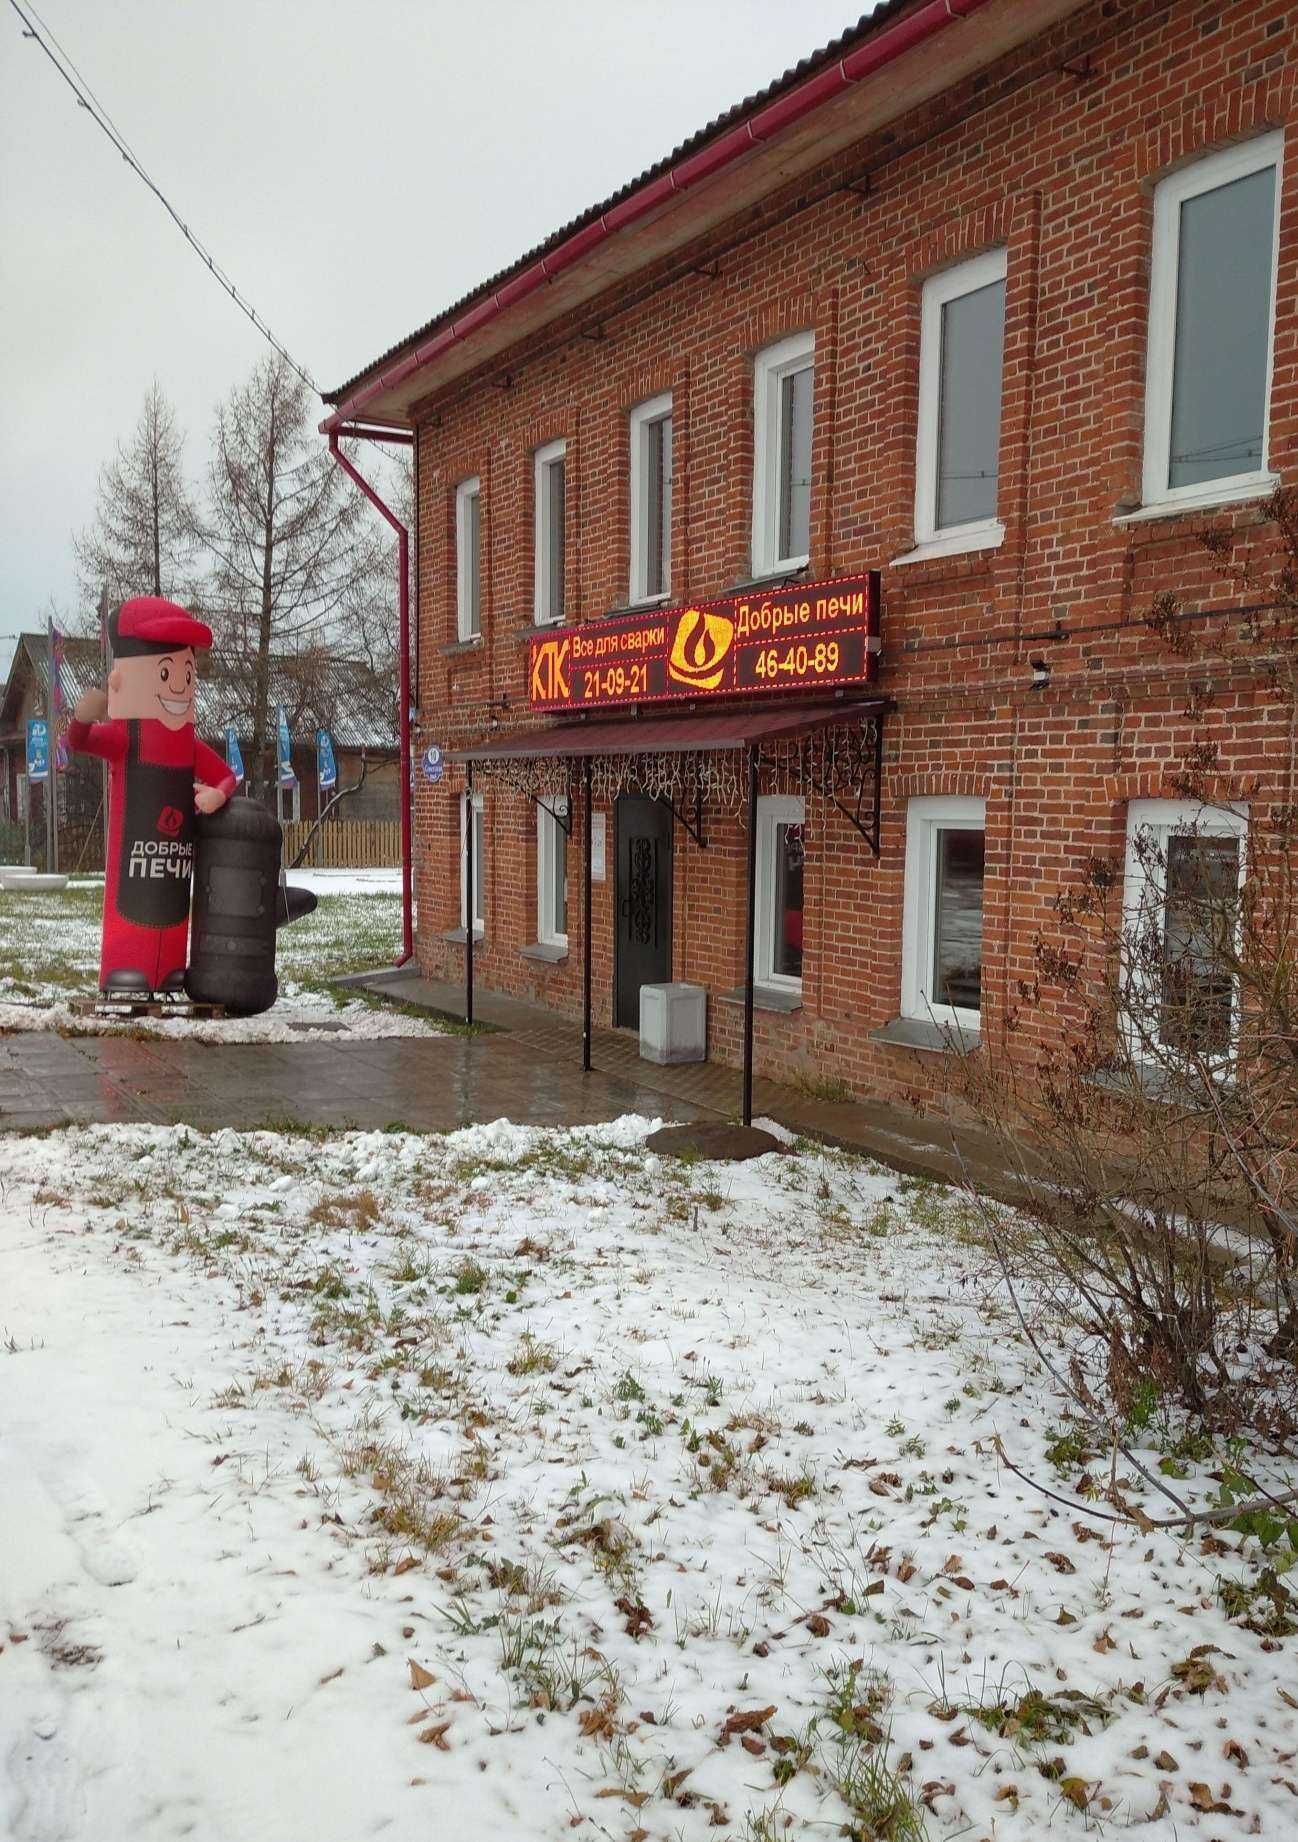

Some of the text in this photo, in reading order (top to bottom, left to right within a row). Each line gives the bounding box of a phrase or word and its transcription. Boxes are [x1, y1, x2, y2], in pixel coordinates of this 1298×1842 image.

[737, 592, 864, 638] Добрые печи
[572, 626, 665, 658] Все для сварки
[755, 641, 840, 678] 46-40-89
[584, 664, 647, 698] 21-09-21
[131, 840, 193, 857] ДОБРЫЕ
[128, 857, 192, 879] ПЕЧИ
